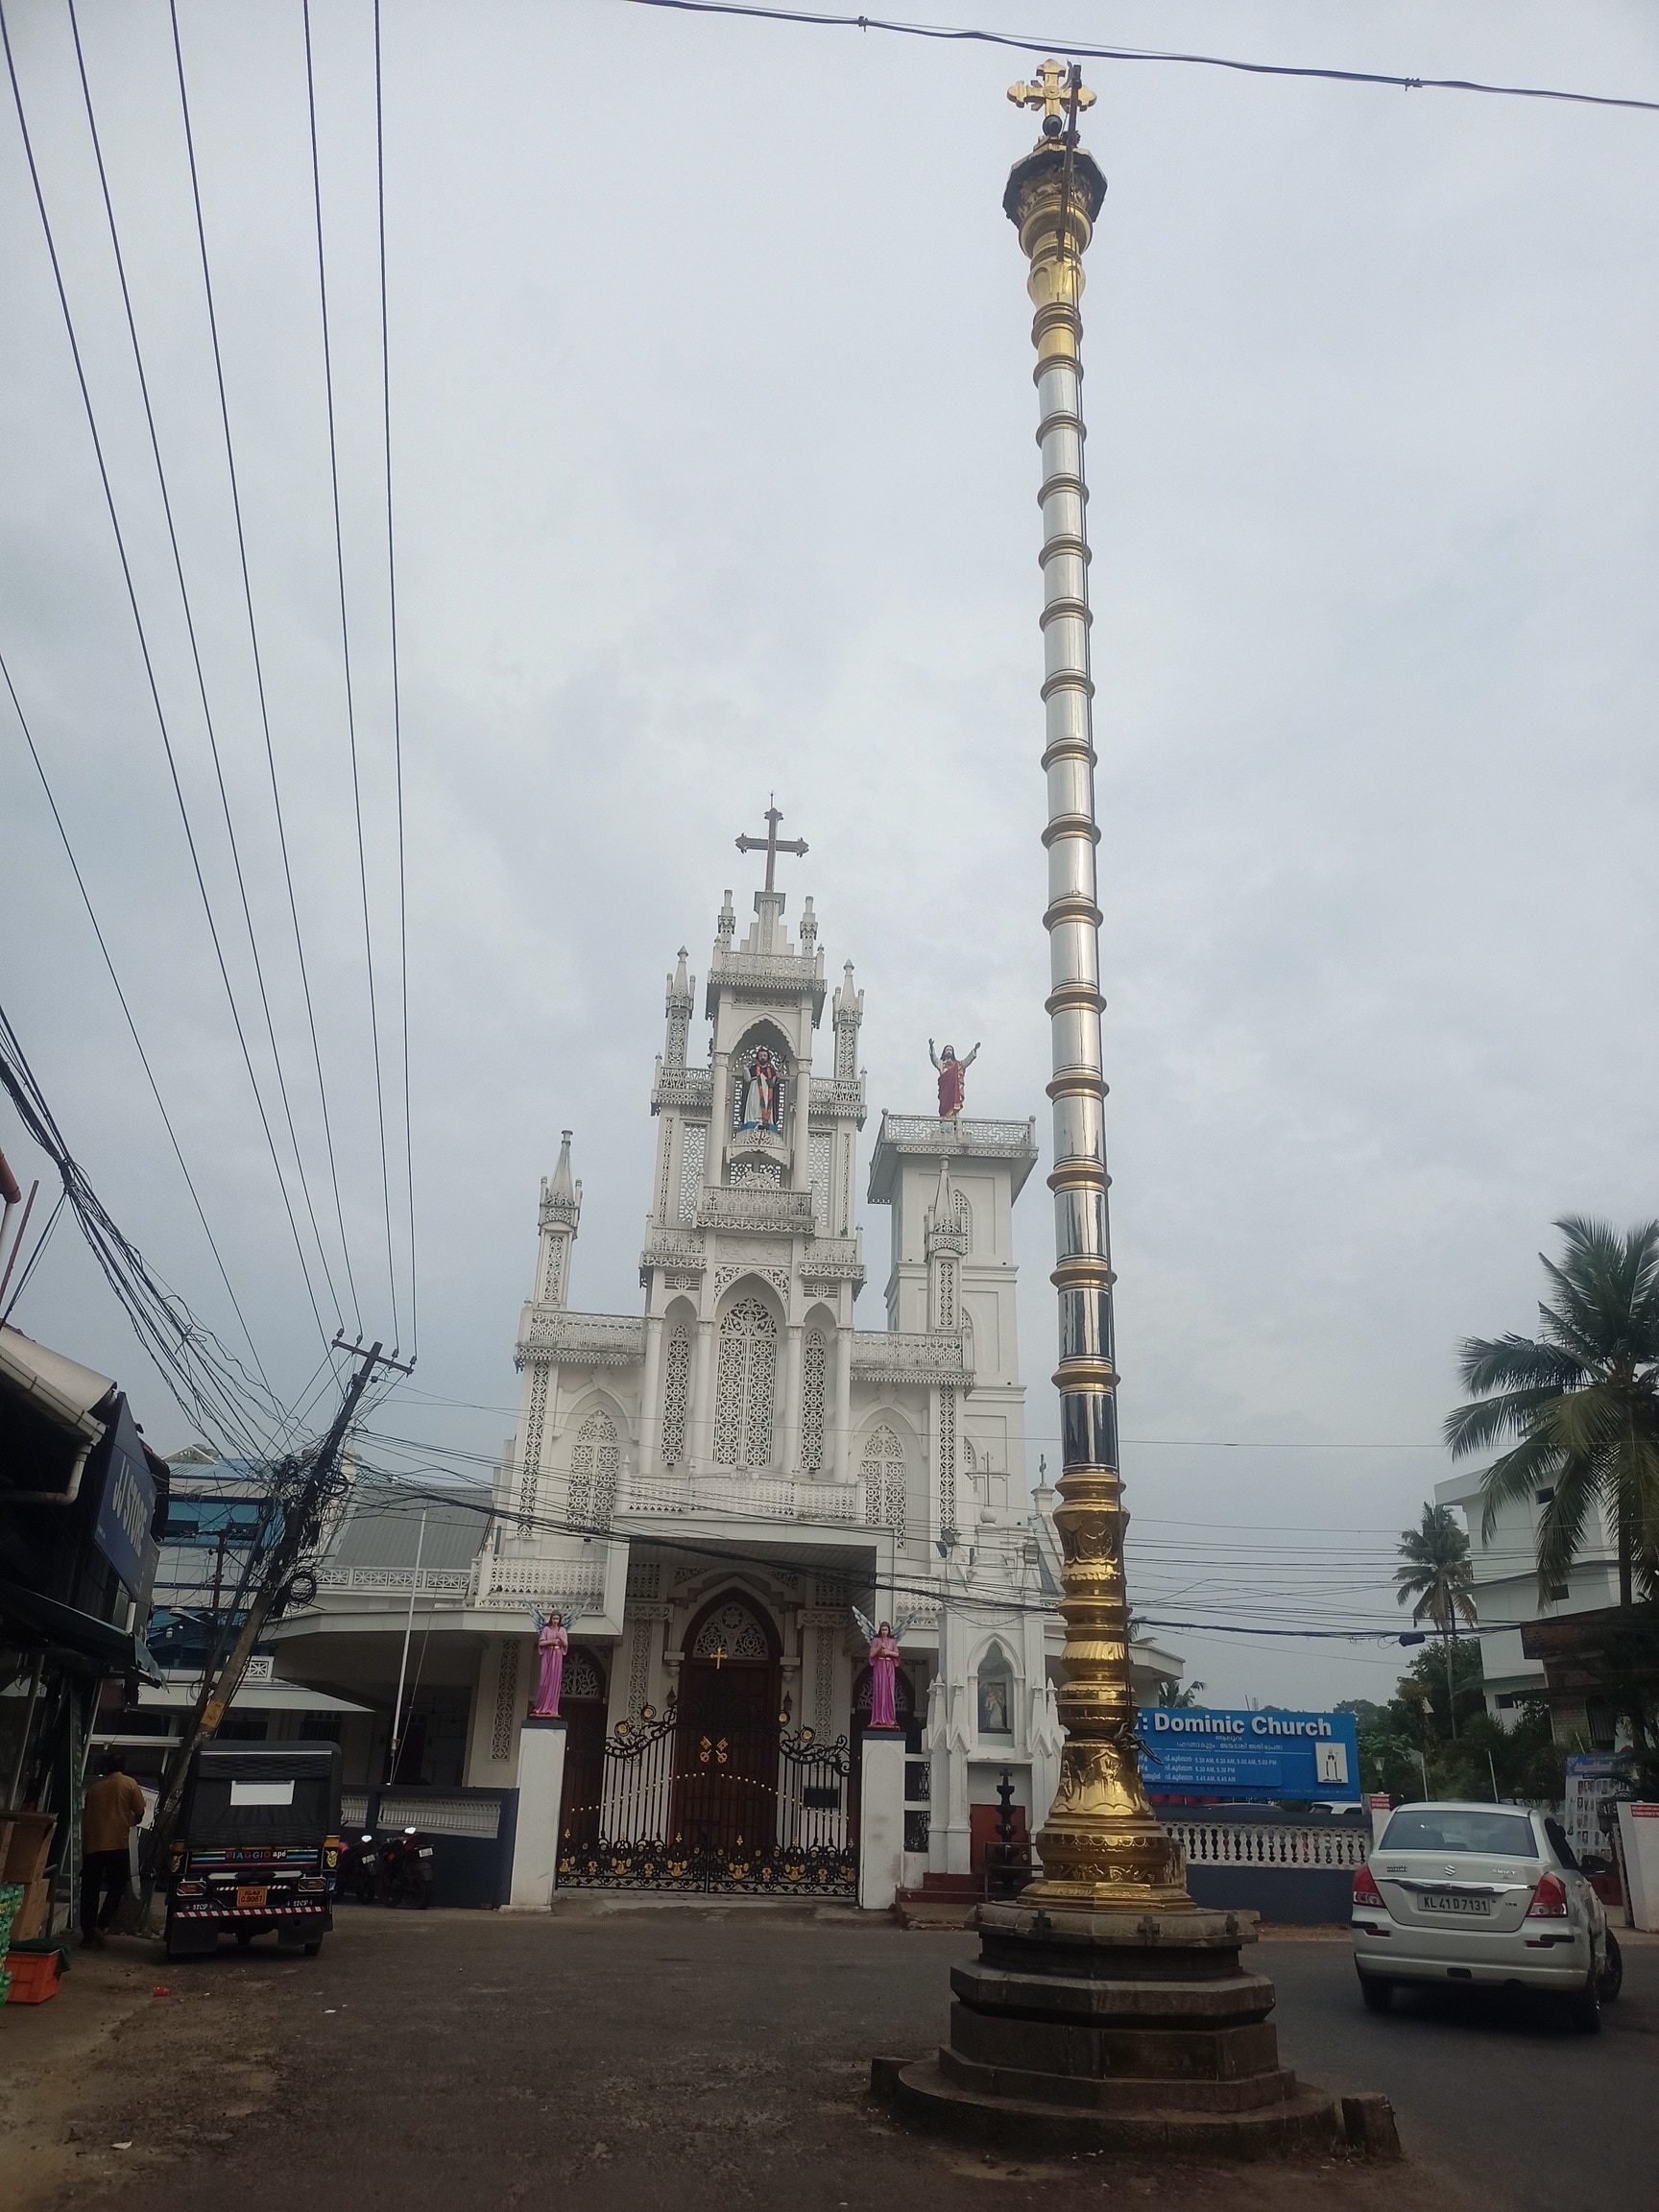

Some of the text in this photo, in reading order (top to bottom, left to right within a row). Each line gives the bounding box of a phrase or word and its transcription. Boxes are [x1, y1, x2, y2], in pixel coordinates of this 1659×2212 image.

[122, 1474, 148, 1557] STORE
[1154, 1713, 1245, 1735] Dominic
[1251, 1716, 1332, 1737] Church
[226, 1850, 271, 1860] PIAGGIO
[1424, 1896, 1436, 1909] KL
